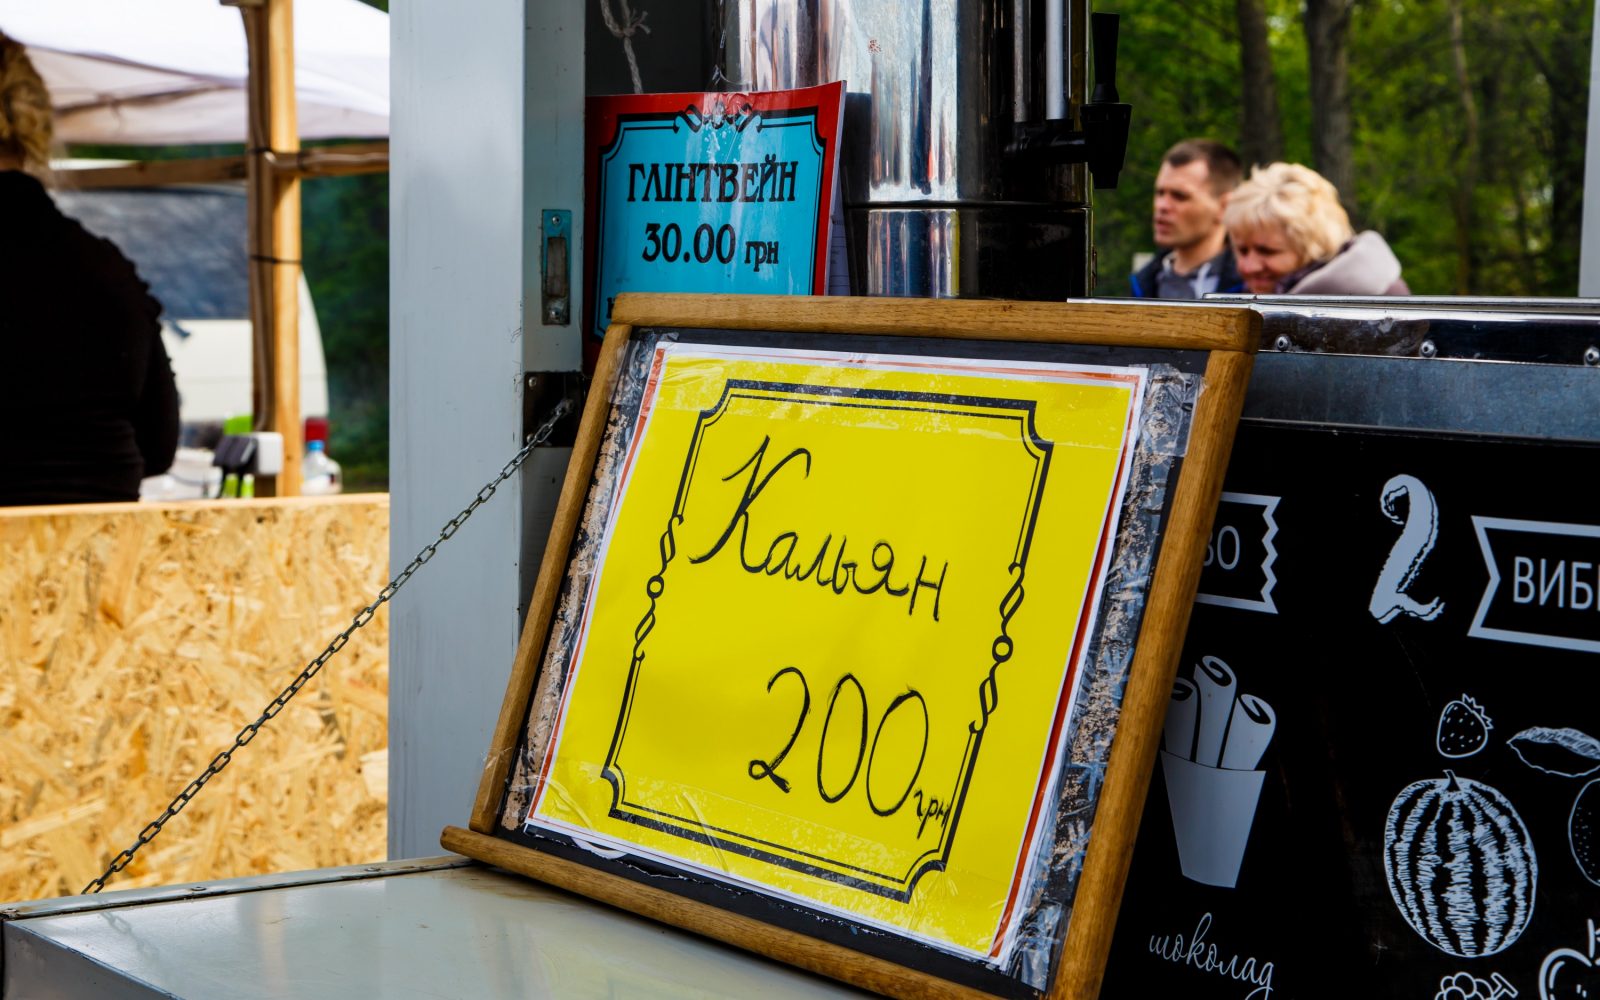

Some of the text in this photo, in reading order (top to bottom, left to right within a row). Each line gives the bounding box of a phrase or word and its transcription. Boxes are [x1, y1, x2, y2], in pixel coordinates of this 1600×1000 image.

[627, 154, 799, 202] ГЛІНТВЕЙН
[642, 223, 779, 272] 30.00 грн
[688, 434, 948, 622] Кальян
[1513, 555, 1600, 612] ВИБ
[748, 666, 929, 817] 200
[1149, 912, 1274, 1000] шоколад
